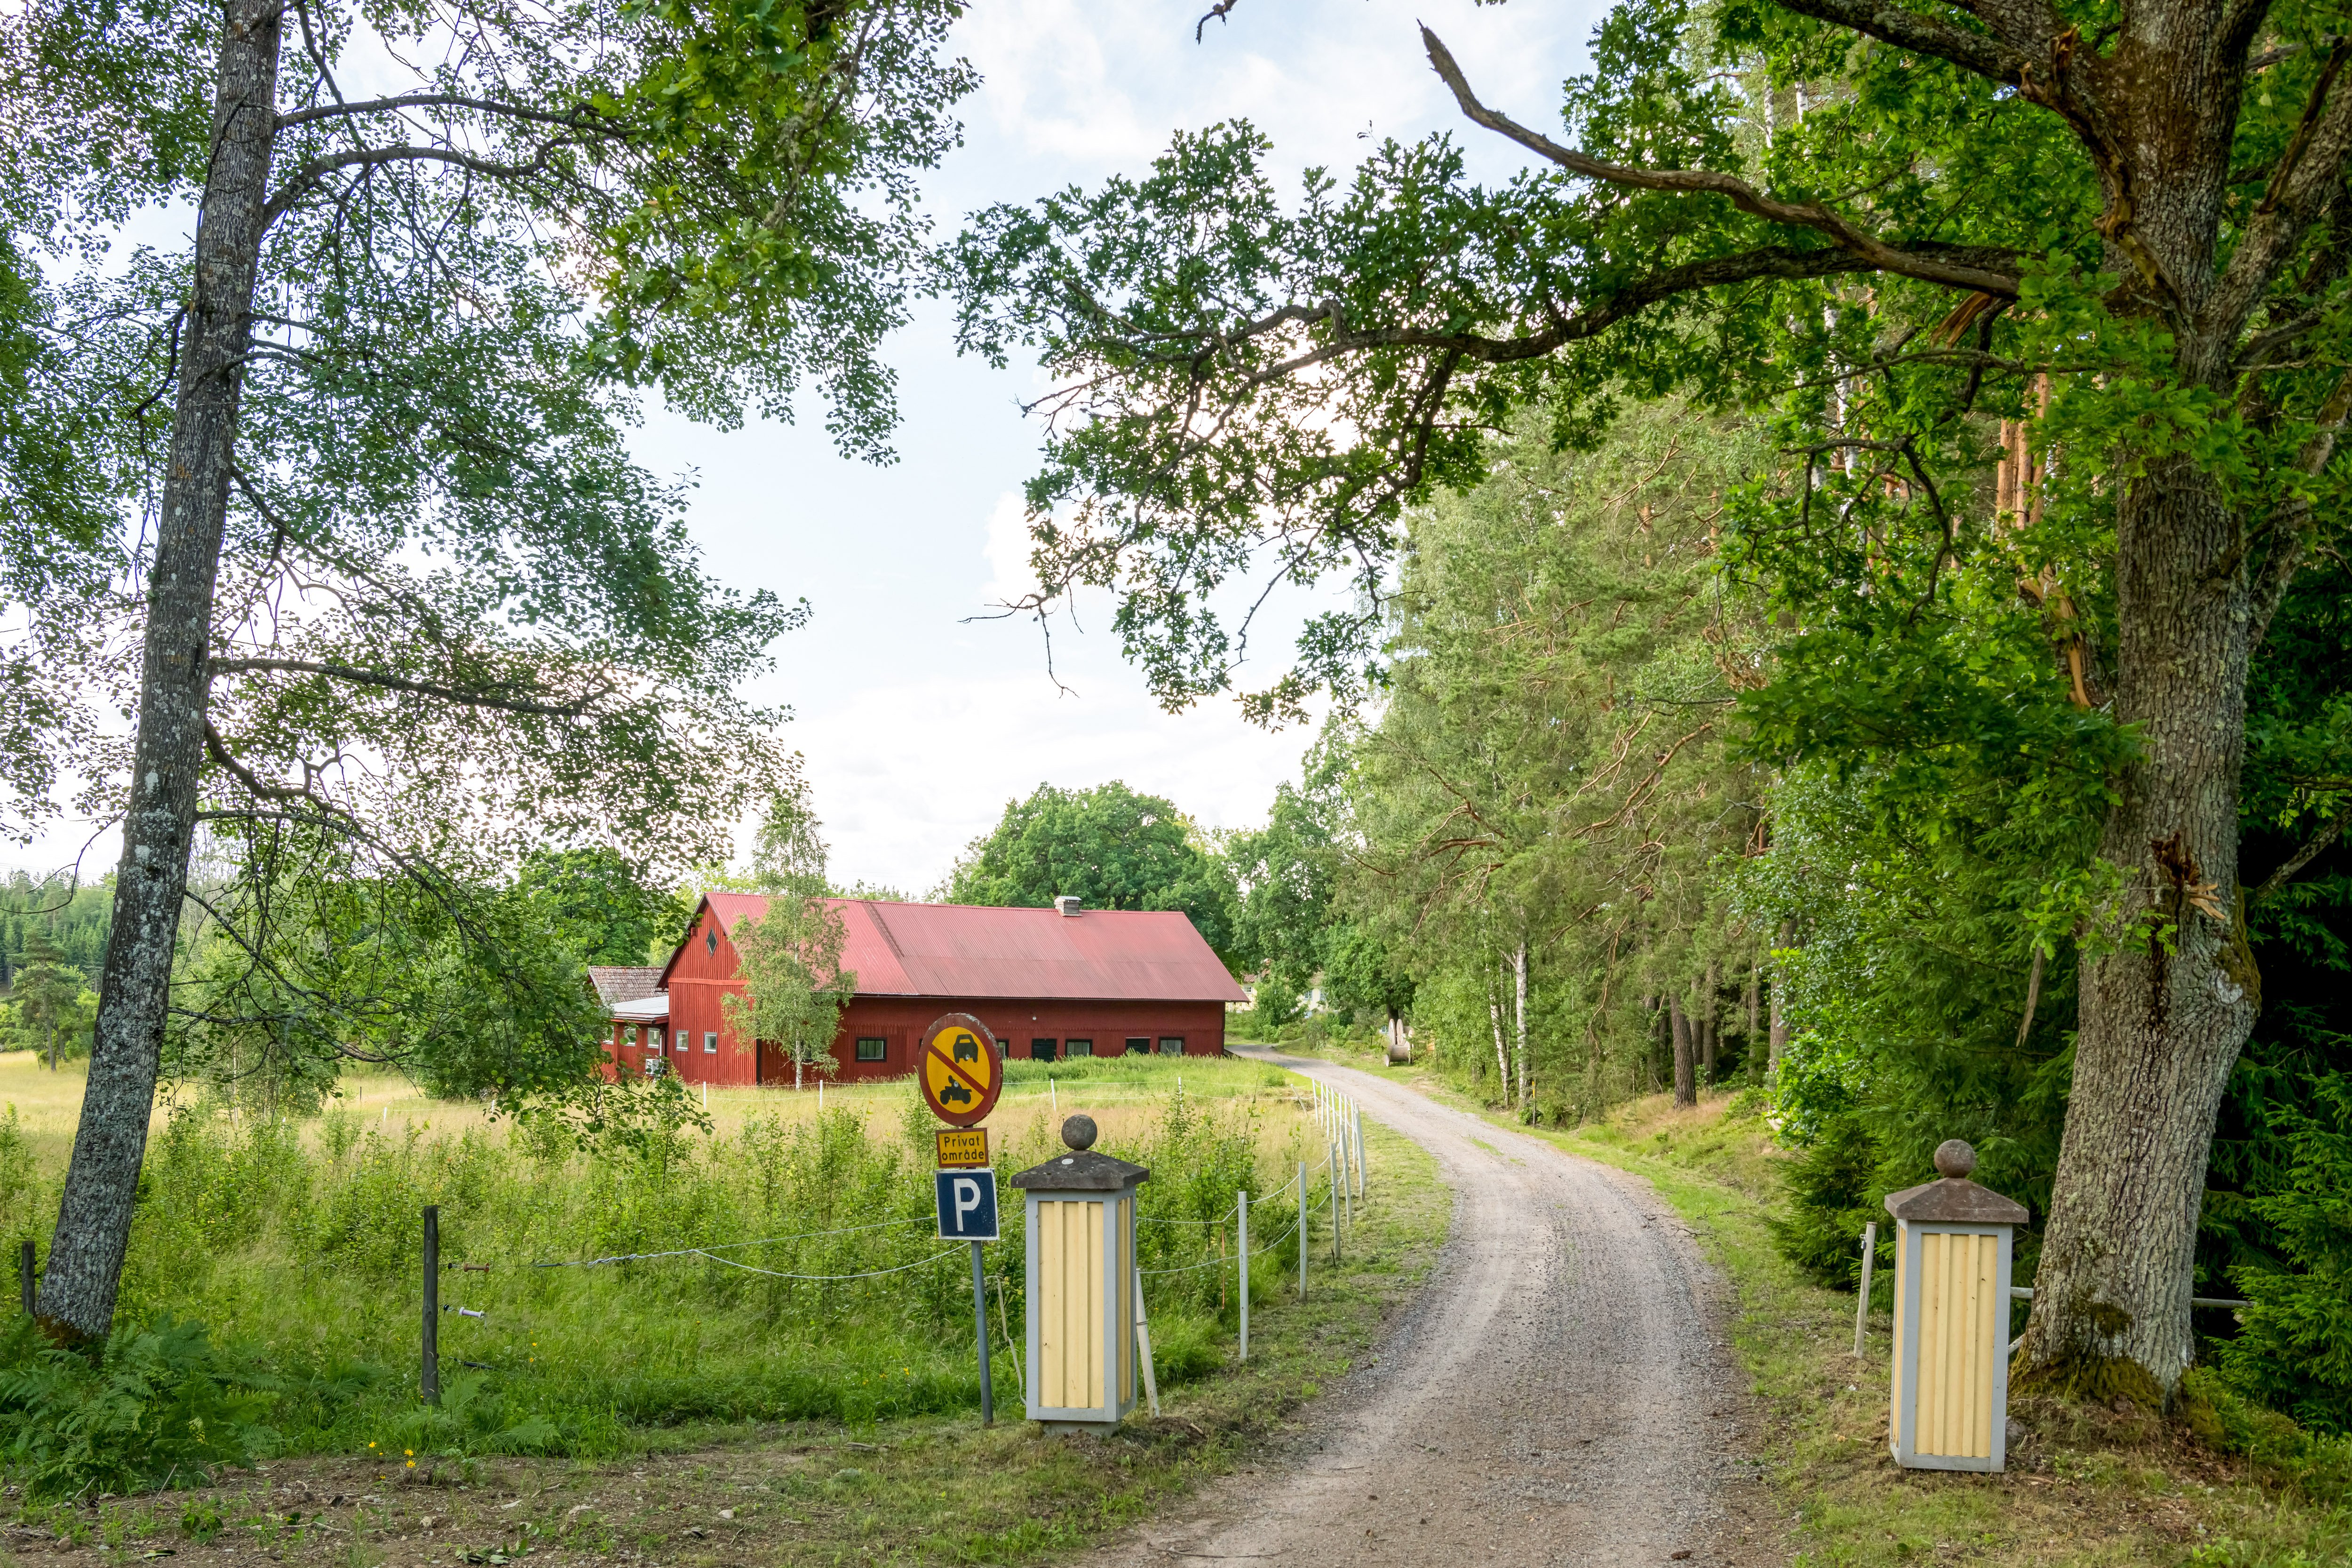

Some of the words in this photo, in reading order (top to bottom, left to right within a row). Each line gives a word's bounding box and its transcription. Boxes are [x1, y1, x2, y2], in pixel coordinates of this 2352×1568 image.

[944, 1135, 980, 1147] Privat
[941, 1148, 985, 1161] område
[954, 1178, 981, 1232] P
